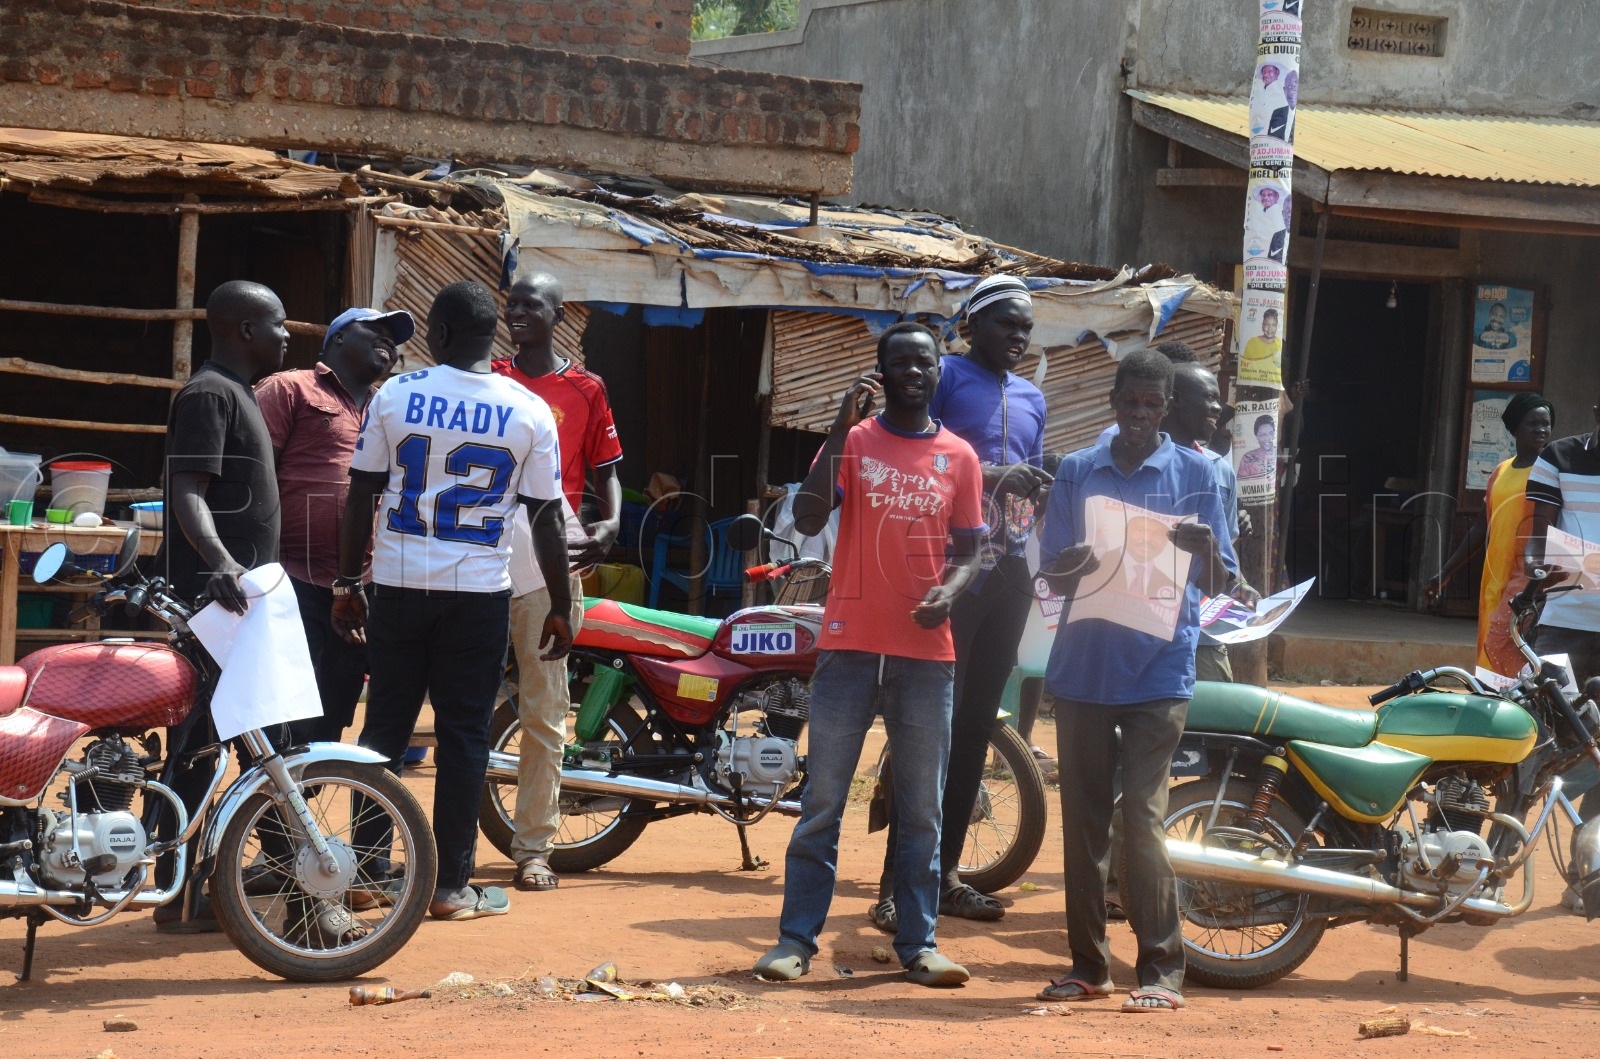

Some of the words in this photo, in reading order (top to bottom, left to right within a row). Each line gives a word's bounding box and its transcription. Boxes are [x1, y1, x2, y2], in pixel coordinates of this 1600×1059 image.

[405, 392, 514, 438] BRADY
[387, 433, 518, 547] 12
[732, 632, 792, 652] JIKO
